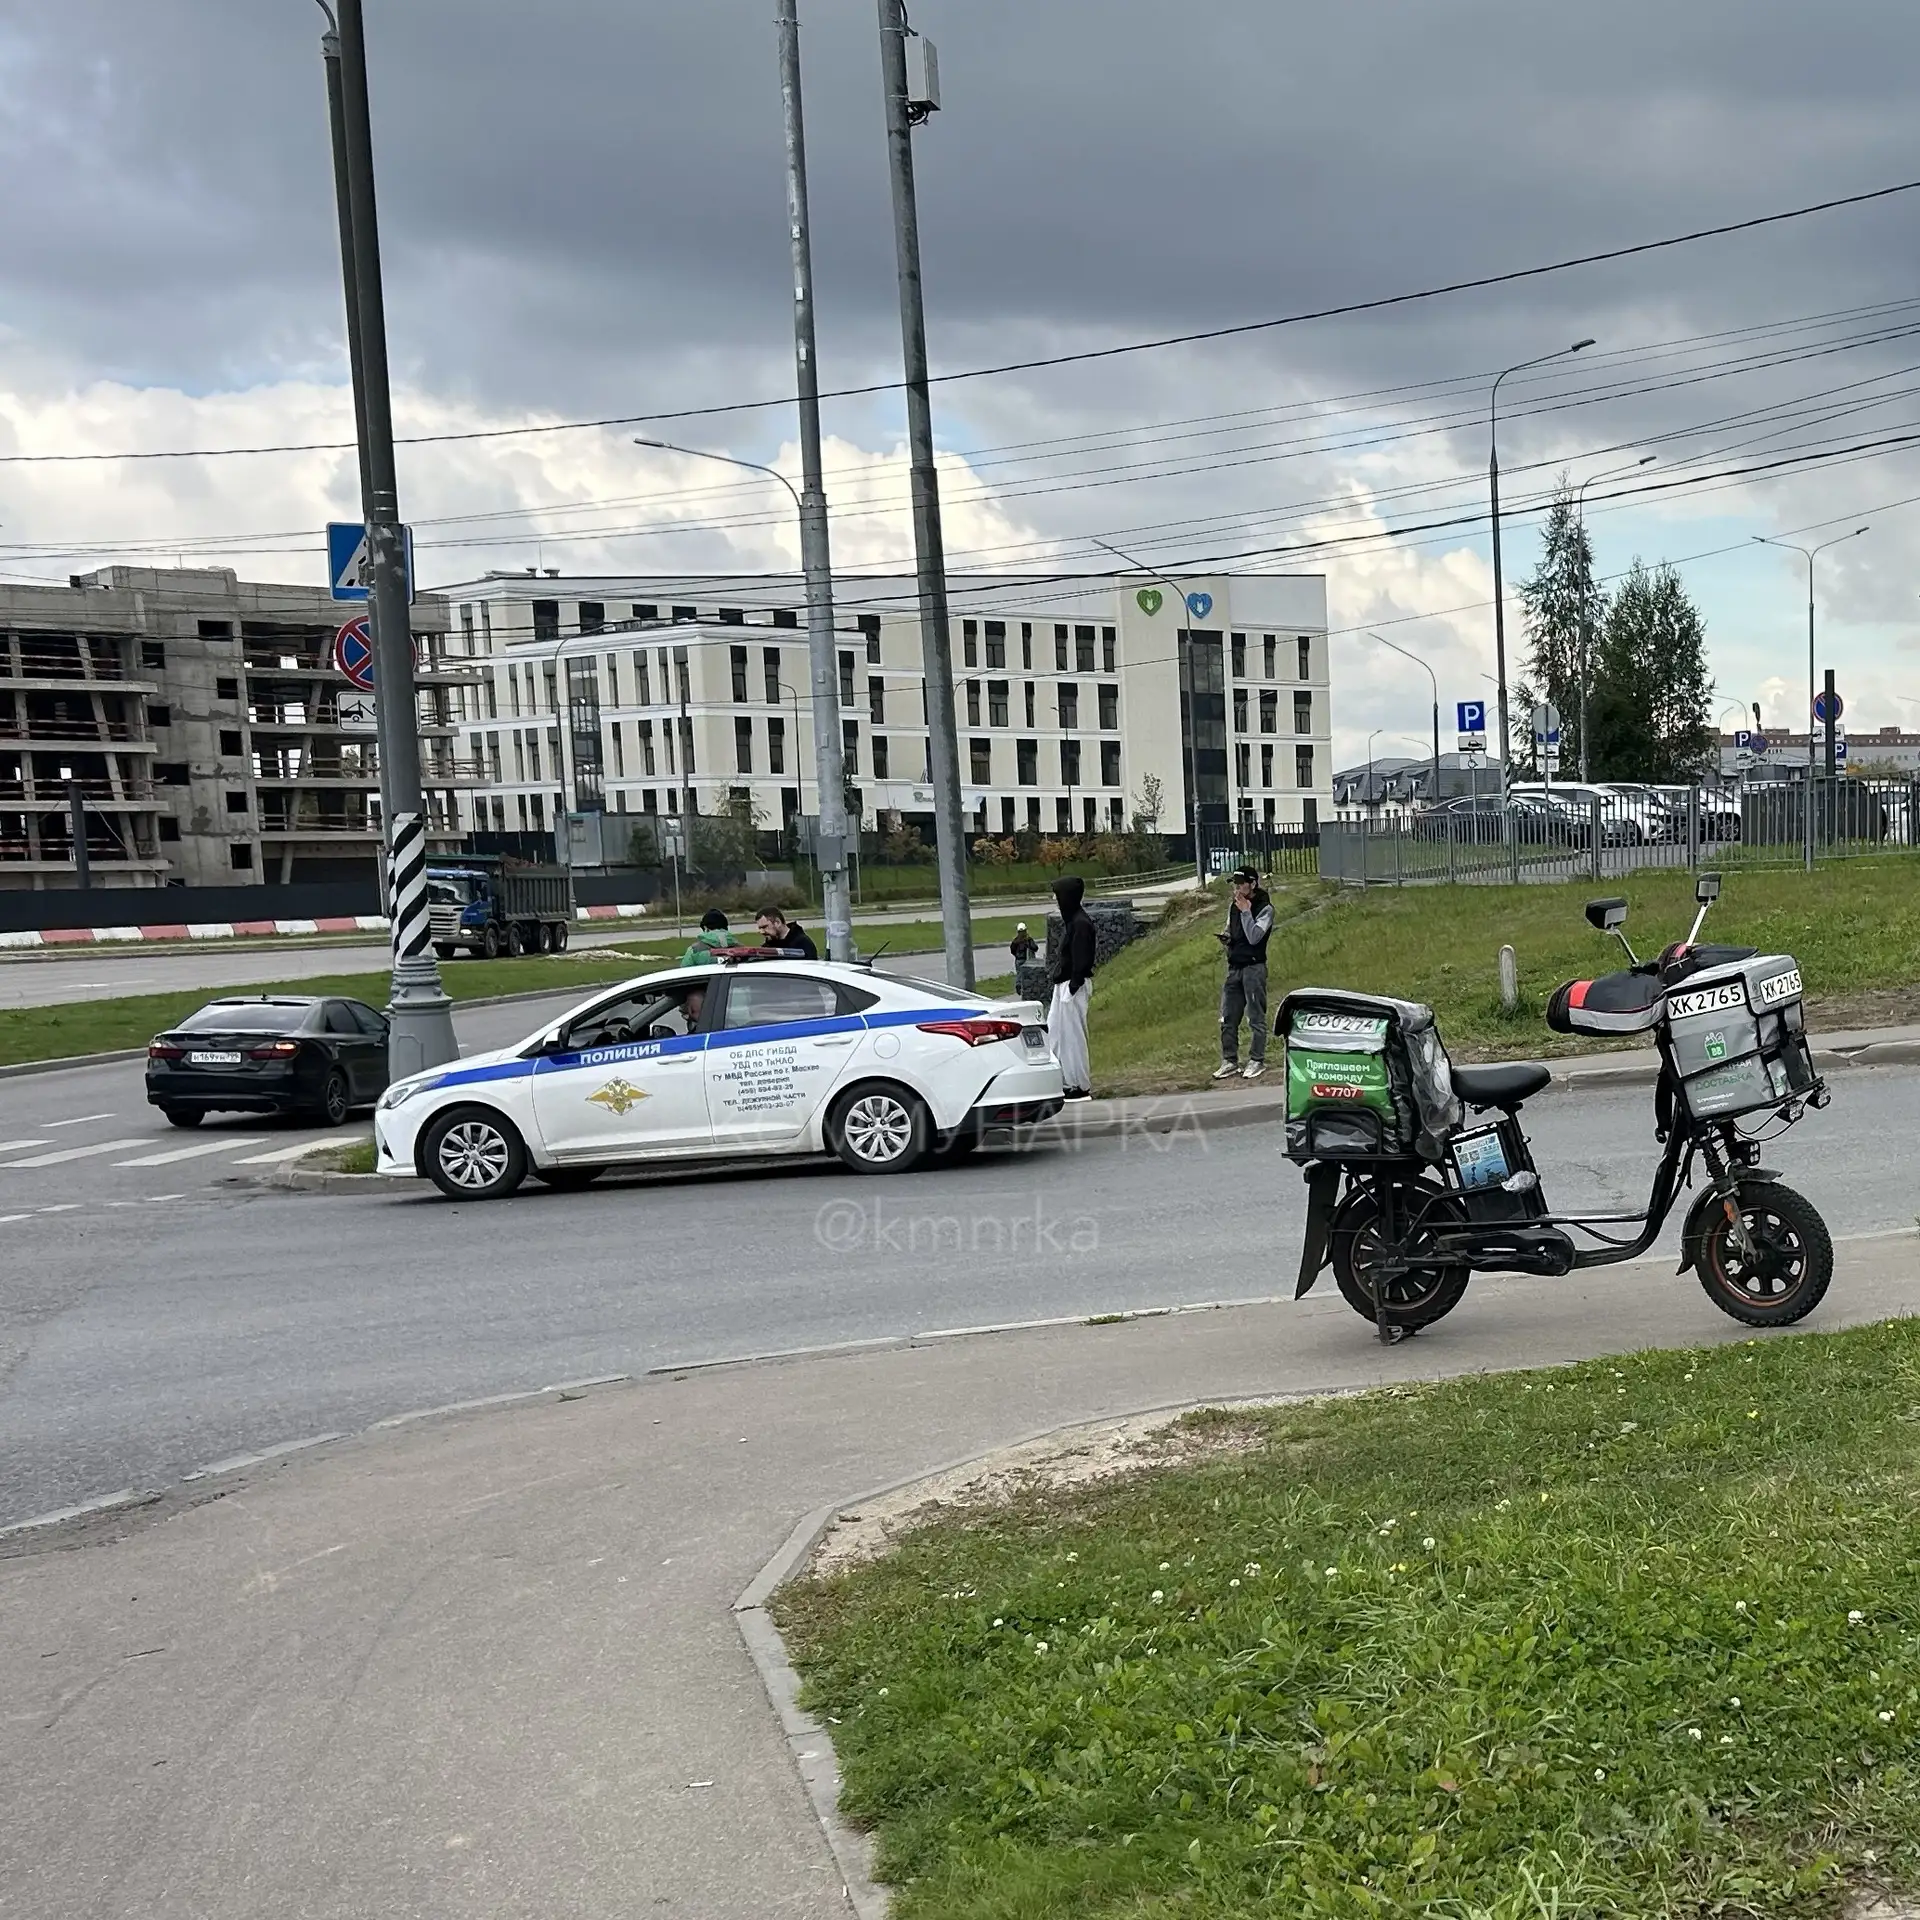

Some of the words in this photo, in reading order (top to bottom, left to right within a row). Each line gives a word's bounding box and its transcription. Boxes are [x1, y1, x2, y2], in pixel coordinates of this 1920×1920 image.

[1464, 705, 1480, 730] P
[1739, 732, 1749, 747] P
[580, 1043, 661, 1065] ПОЛИЦИЯ
[730, 1051, 743, 1059] ОБ
[745, 1049, 764, 1058] ДПС
[767, 1046, 797, 1055] ГИБДД
[732, 1061, 751, 1069] УВД
[753, 1060, 763, 1068] по
[765, 1056, 794, 1066] ТиНАО
[1306, 1059, 1370, 1073] Приглашаем
[713, 1074, 722, 1082] ГУ
[725, 1072, 743, 1080] МВД
[745, 1069, 772, 1078] России
[1318, 1073, 1364, 1084] команду
[1695, 1072, 1756, 1092] ДОСТАВКА
